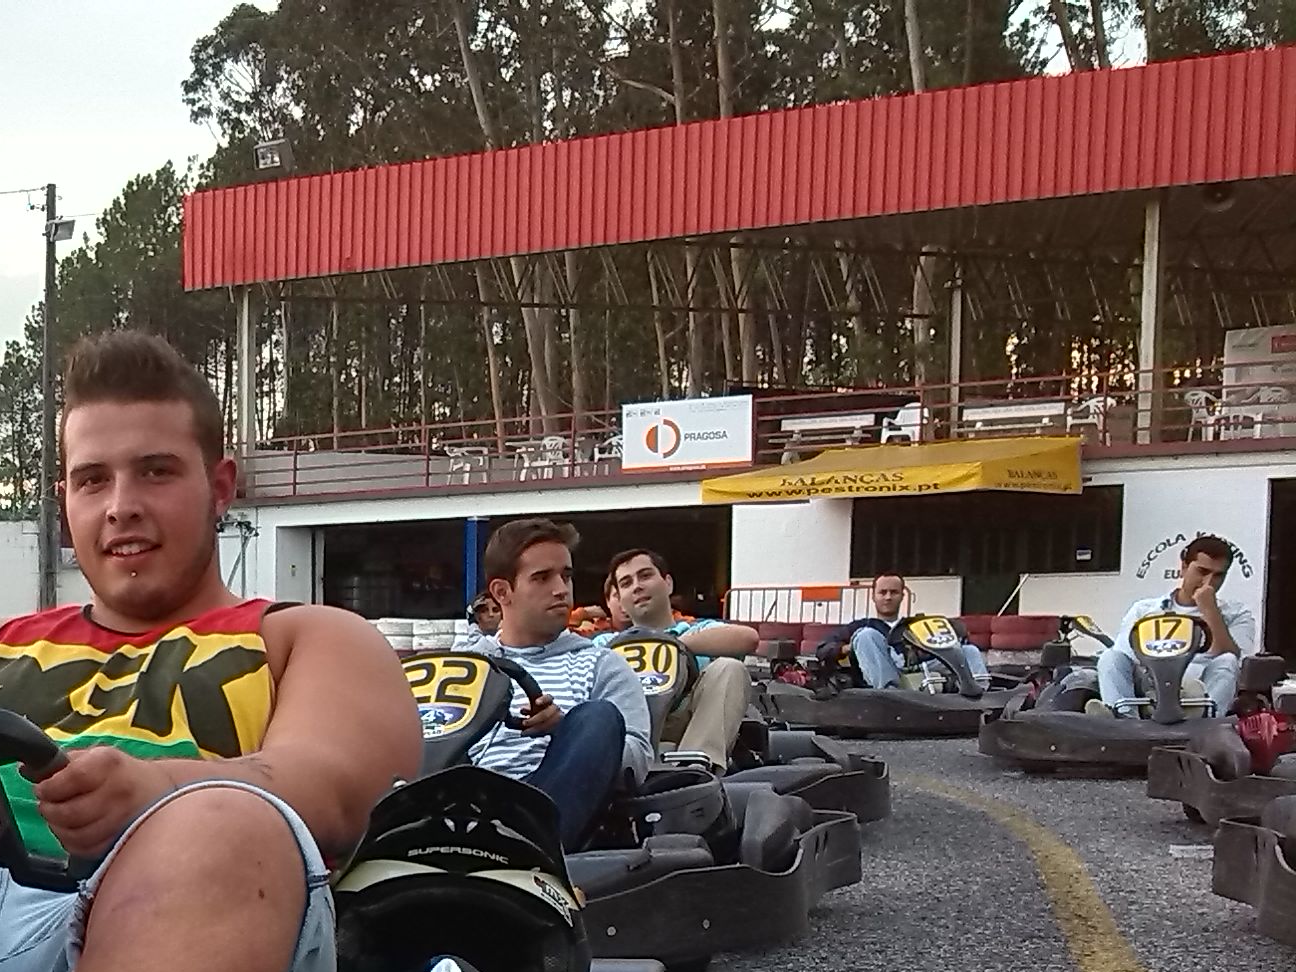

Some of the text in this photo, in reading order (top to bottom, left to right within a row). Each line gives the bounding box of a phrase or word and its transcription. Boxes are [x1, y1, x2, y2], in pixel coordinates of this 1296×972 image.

[684, 431, 728, 441] PRAGOSA
[747, 482, 940, 498] www.pestronix.pt
[1136, 533, 1186, 579] ESCOLA
[922, 619, 953, 637] 13
[1154, 619, 1182, 640] 17
[623, 643, 672, 673] 30
[404, 660, 478, 706] 22
[407, 846, 509, 864] SUPERSONIC
